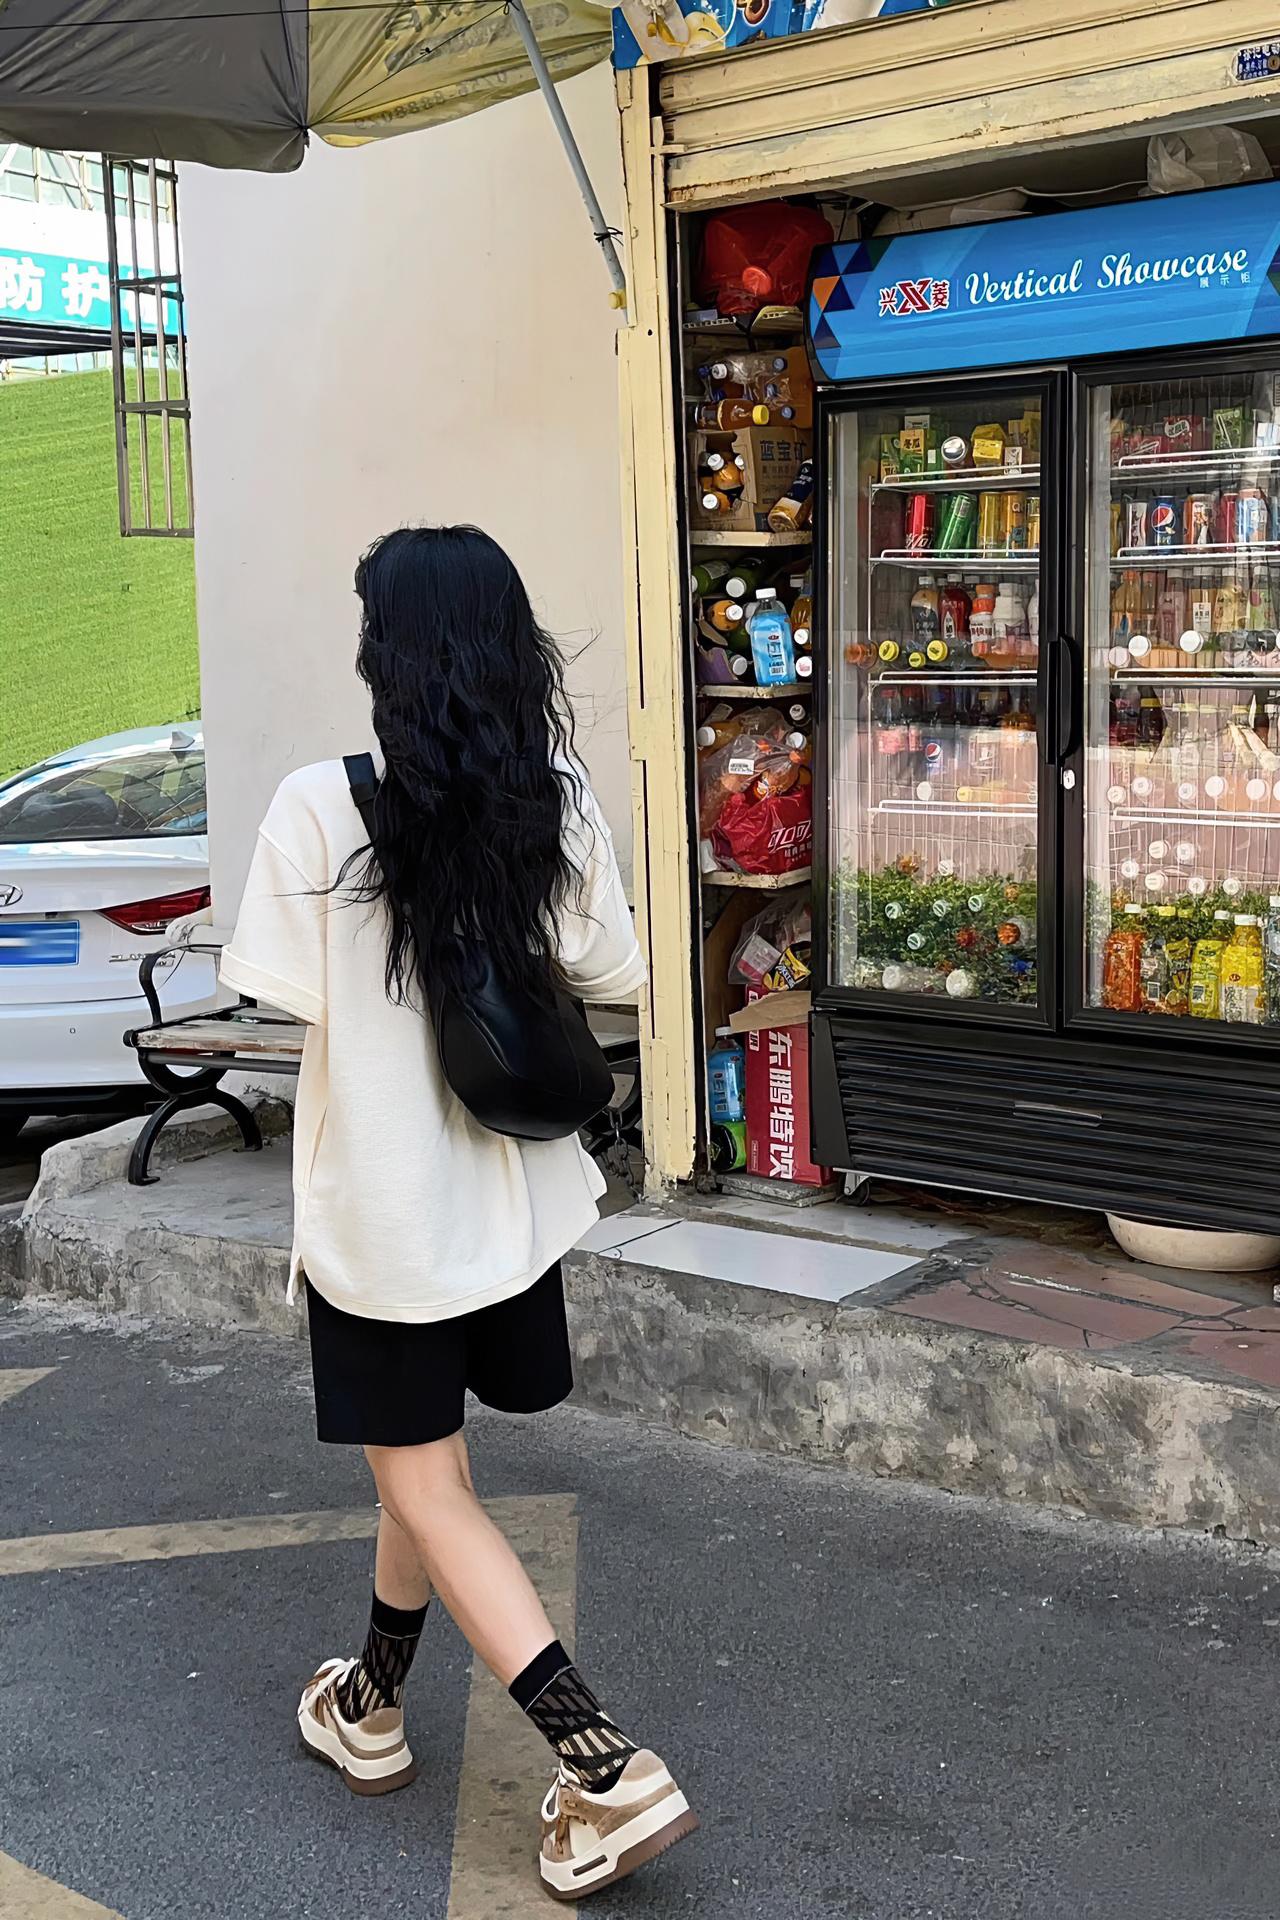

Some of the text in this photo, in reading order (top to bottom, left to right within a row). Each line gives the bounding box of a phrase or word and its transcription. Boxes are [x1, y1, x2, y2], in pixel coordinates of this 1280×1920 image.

[965, 249, 1249, 305] Vertical Showcase
[768, 819, 813, 854] 可口可
[769, 1030, 795, 1180] 东鹏特饮
